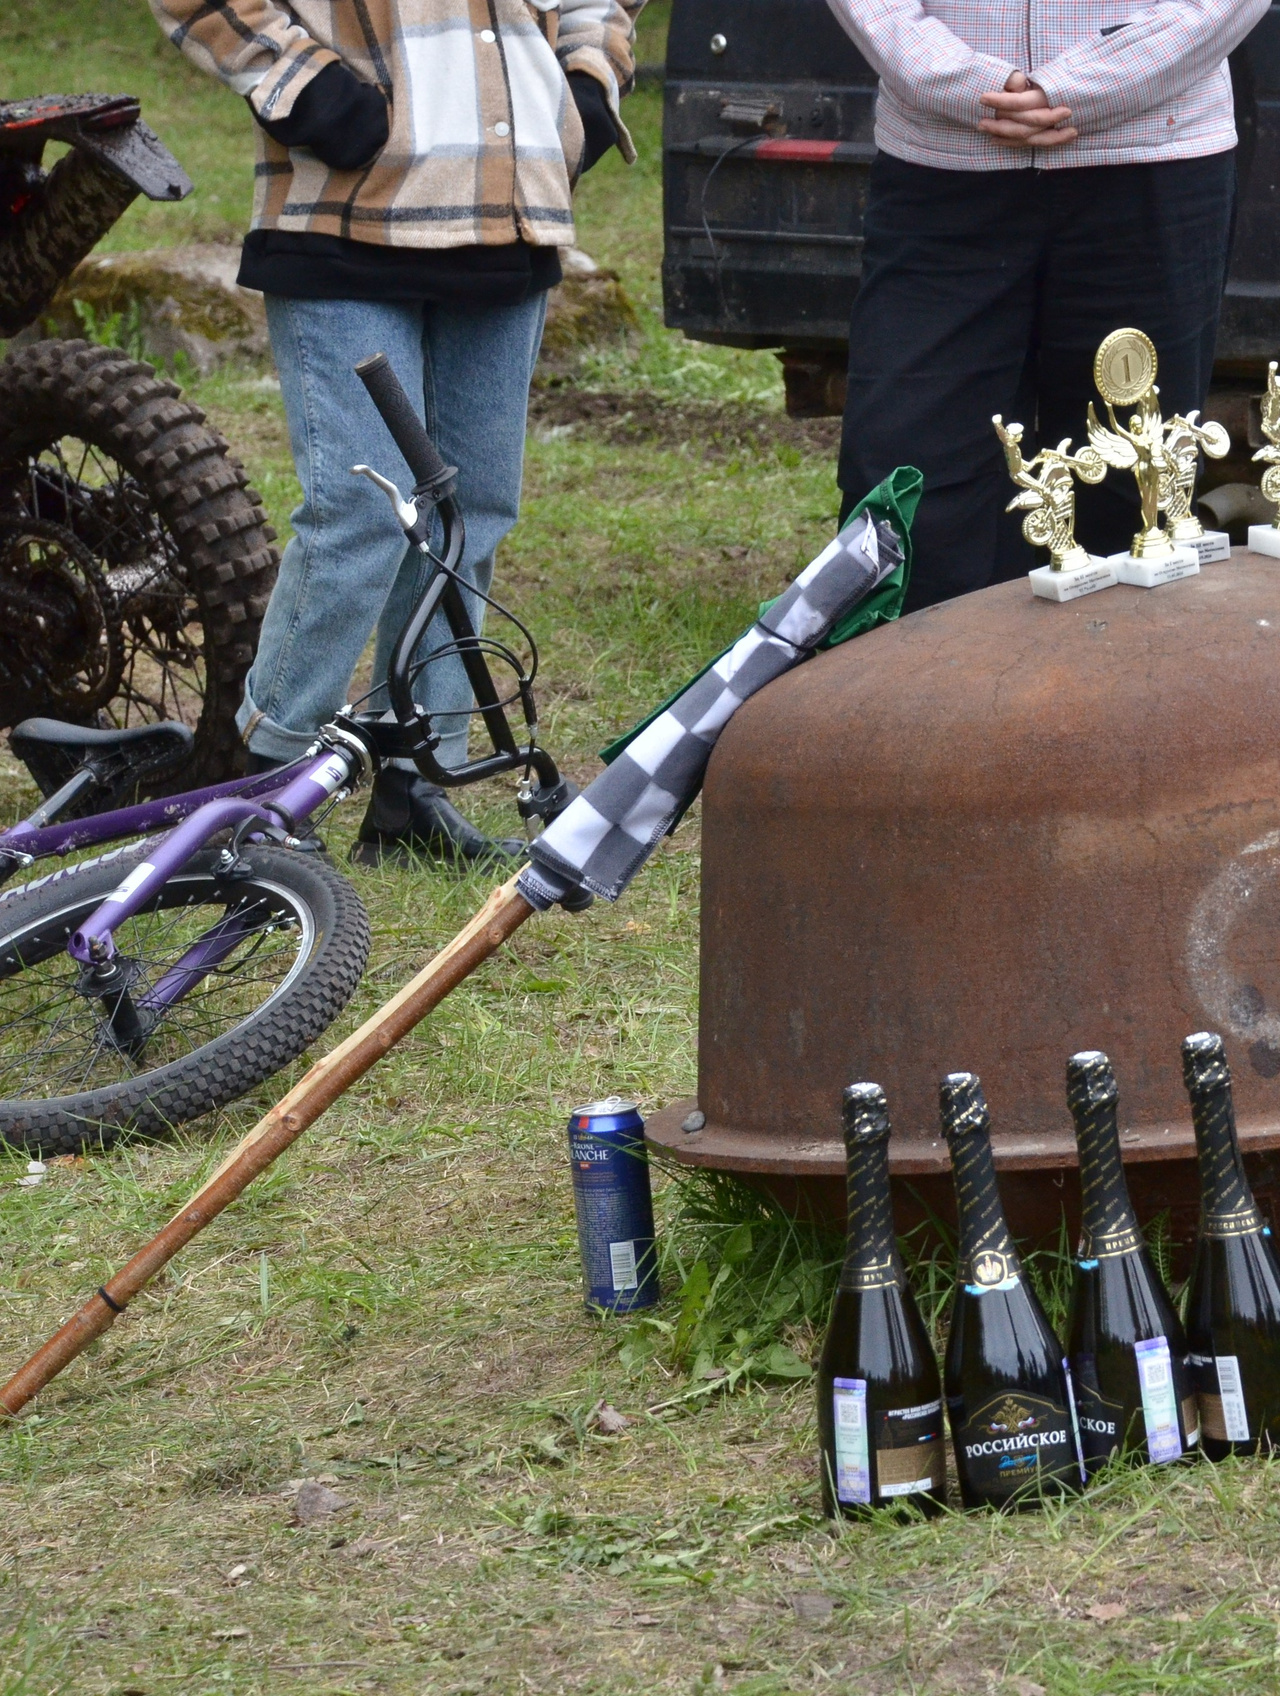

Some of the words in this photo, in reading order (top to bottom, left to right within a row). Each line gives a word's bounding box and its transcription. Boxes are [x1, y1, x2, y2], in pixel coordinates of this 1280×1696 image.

[1121, 354, 1131, 383] 1
[570, 1150, 609, 1160] LANCHE
[965, 1429, 1067, 1458] РОССИЙСКОЕ
[1000, 1466, 1040, 1477] ПРЕМИУ
